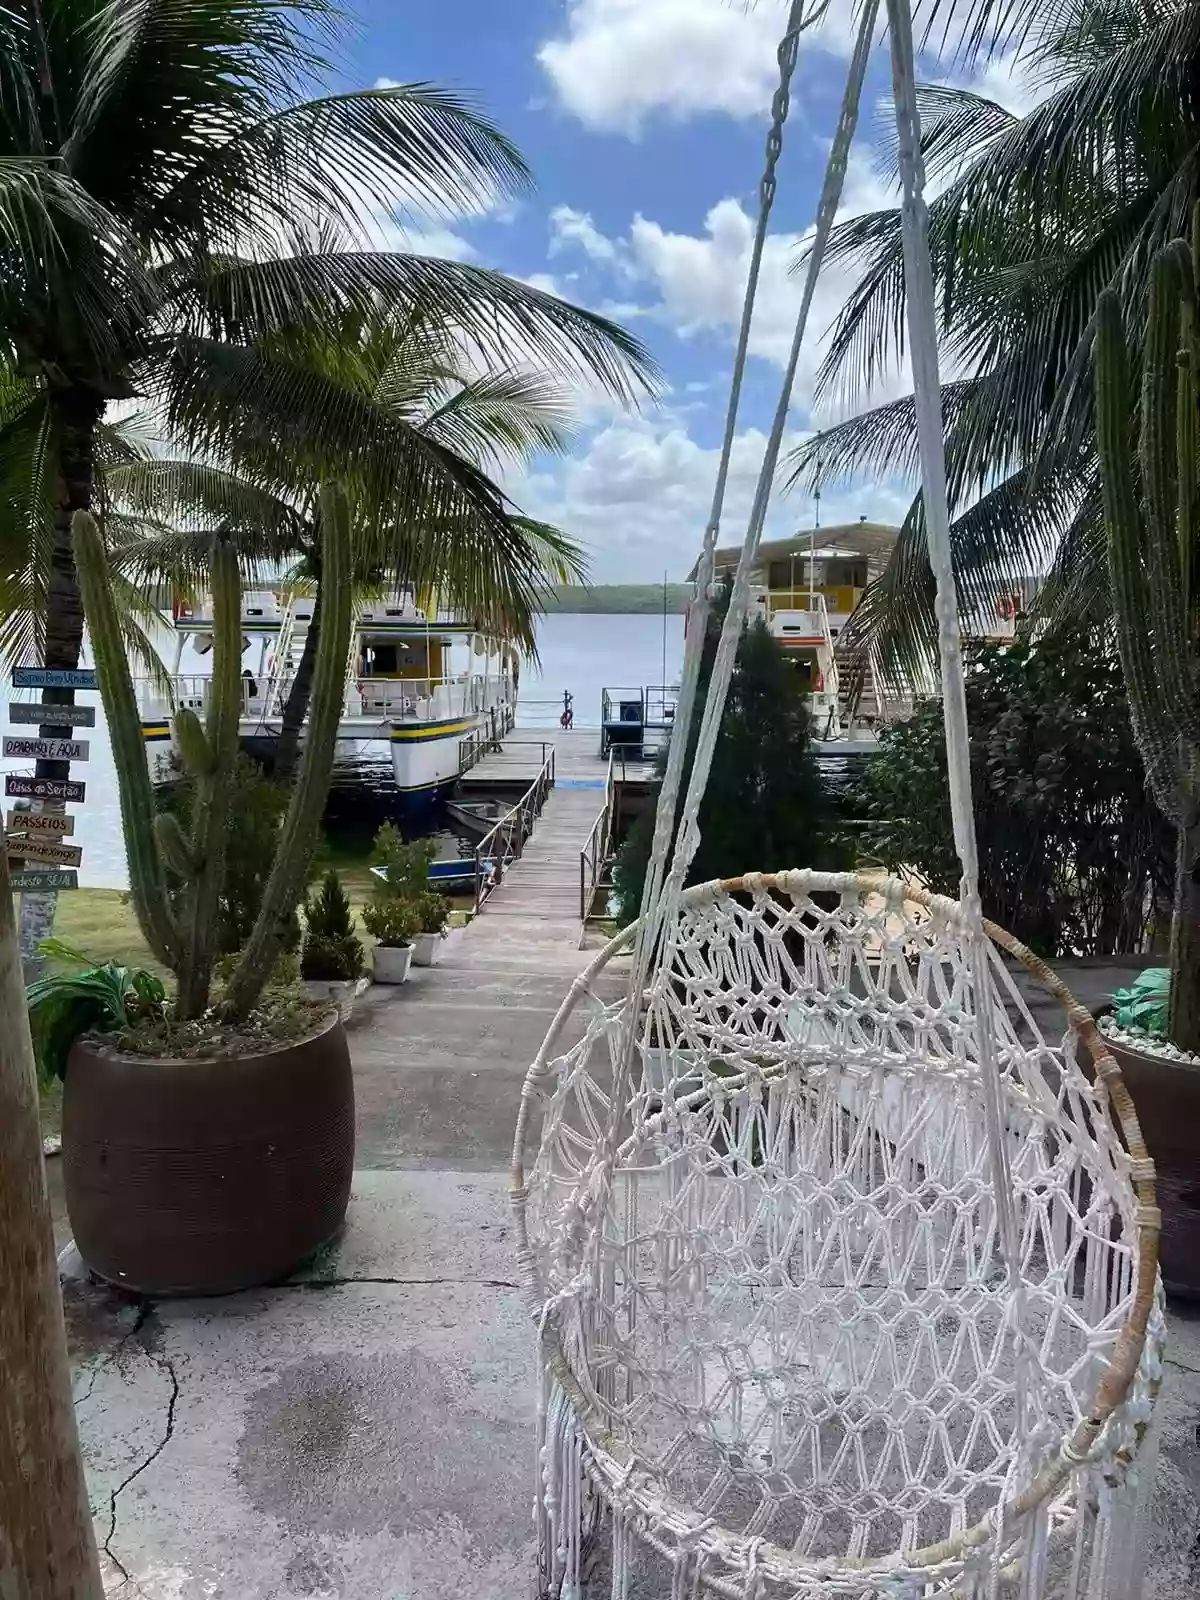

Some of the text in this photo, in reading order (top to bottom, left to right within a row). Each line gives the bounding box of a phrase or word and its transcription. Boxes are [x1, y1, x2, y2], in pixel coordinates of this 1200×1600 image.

[56, 742, 80, 757] AQUI
[46, 781, 78, 797] Sertão
[13, 815, 66, 830] PASSEIOS
